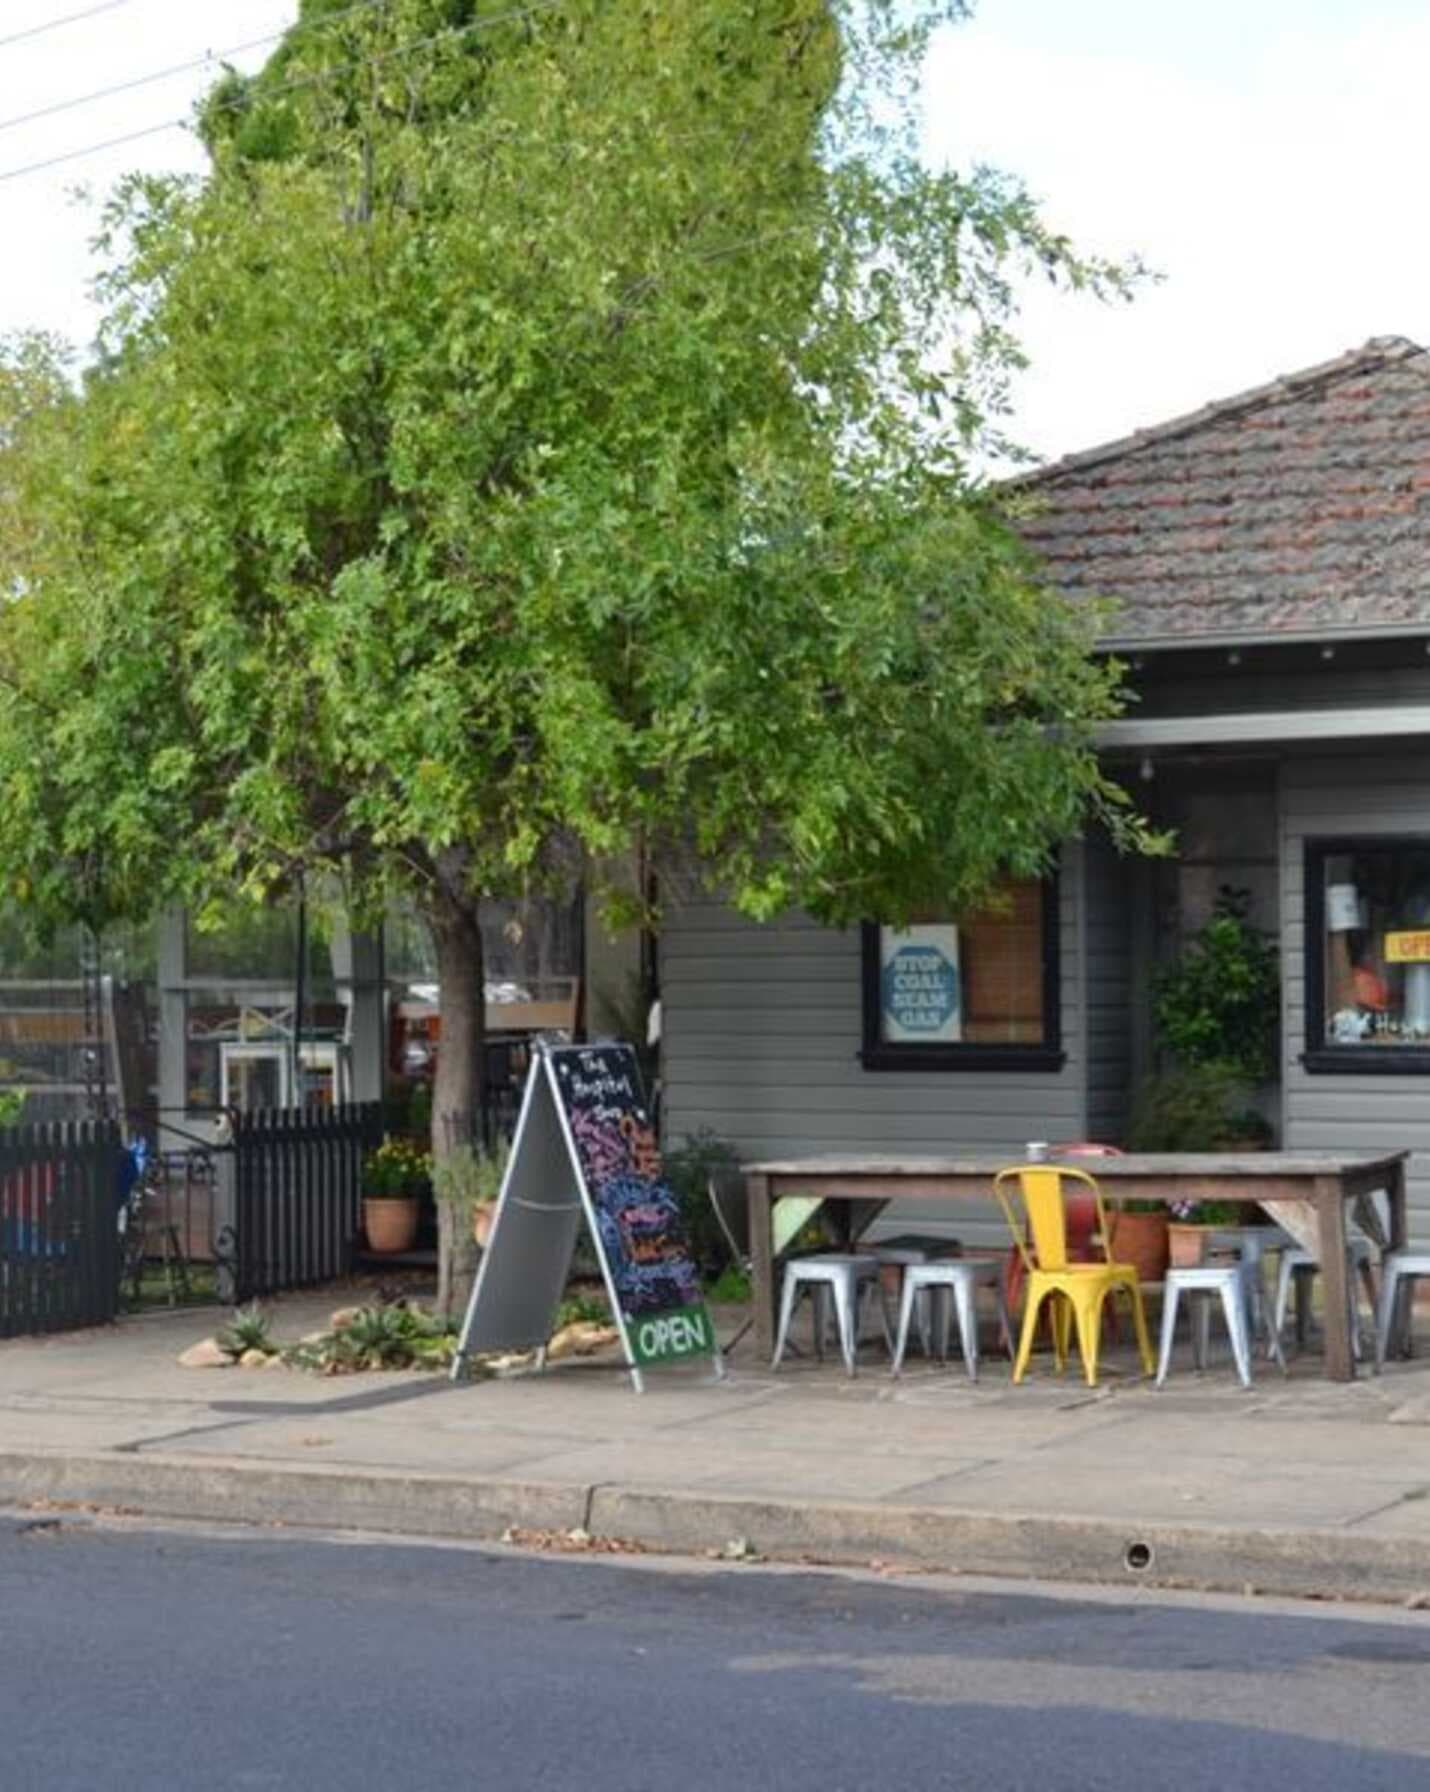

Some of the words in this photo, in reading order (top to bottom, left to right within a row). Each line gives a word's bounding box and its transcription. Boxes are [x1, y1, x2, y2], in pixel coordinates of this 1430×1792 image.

[895, 956, 942, 972] STOP
[893, 973, 944, 989] COAL
[892, 992, 946, 1008] SEAM
[900, 1009, 940, 1026] GAS
[639, 1314, 706, 1357] OPEN
